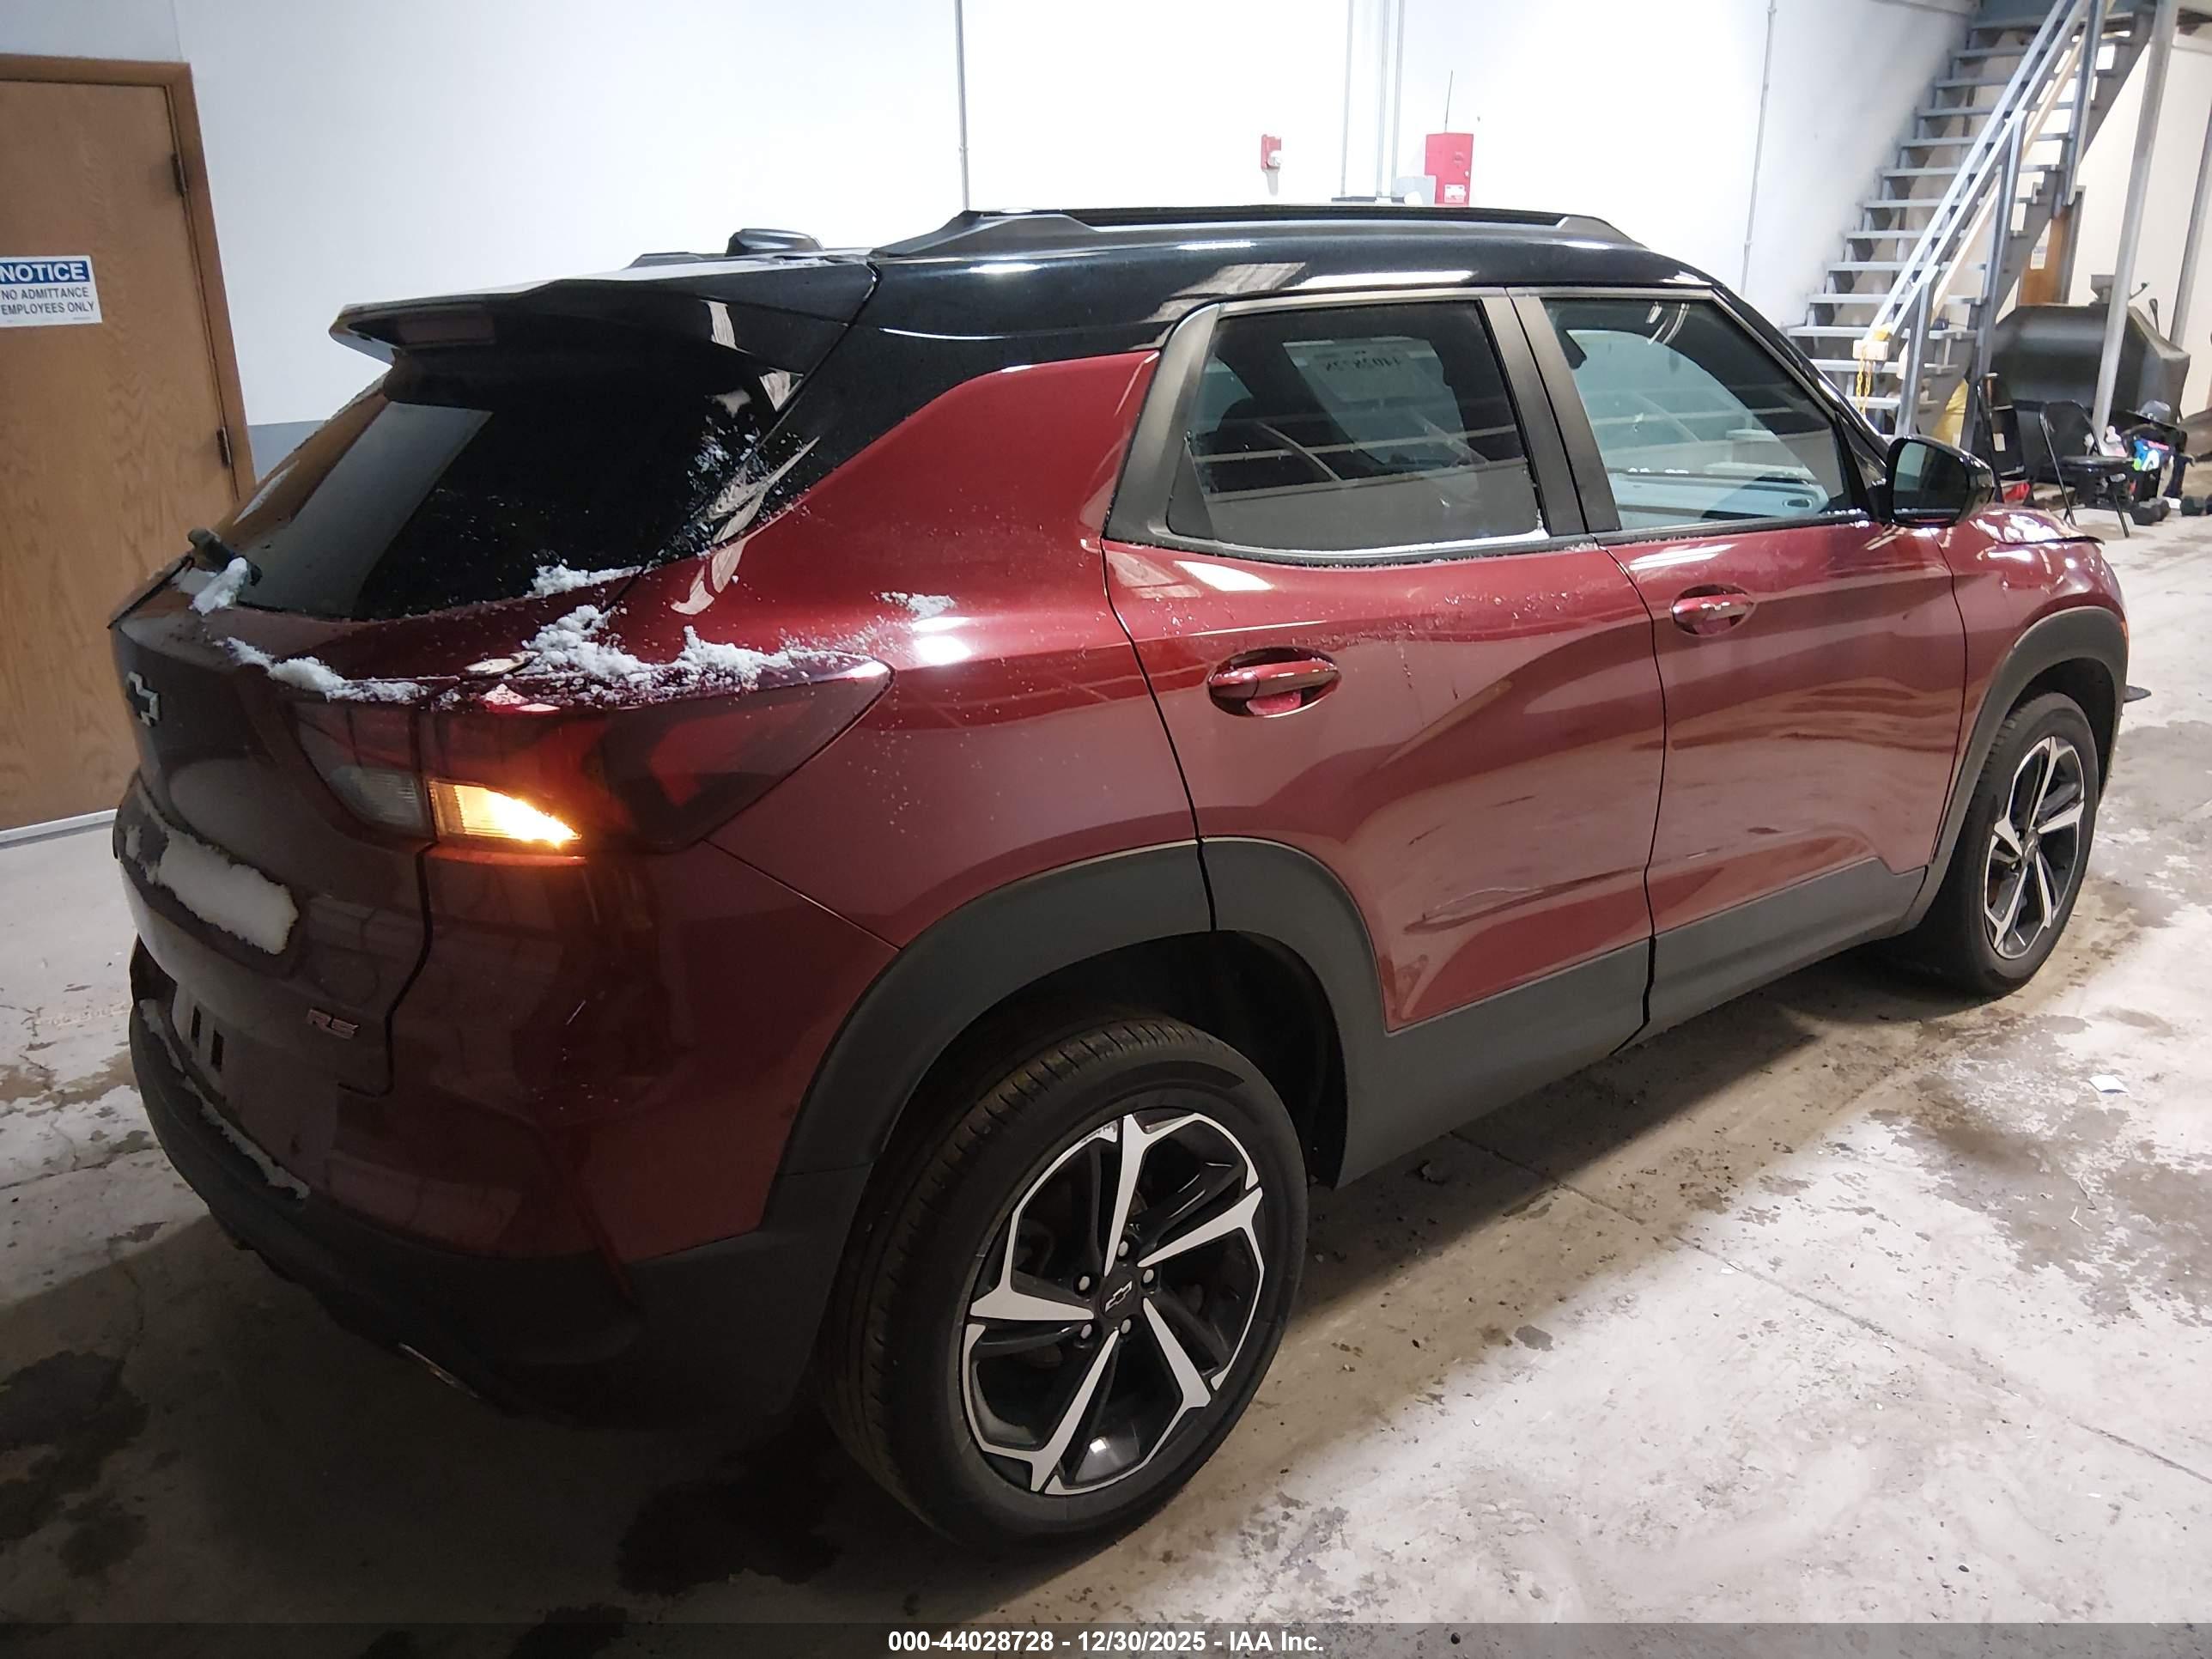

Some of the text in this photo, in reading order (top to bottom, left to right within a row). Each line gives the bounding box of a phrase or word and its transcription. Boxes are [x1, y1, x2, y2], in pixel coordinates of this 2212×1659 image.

[0, 263, 87, 283] NOTICE
[2, 287, 89, 301] NO ADMITTANCE
[2, 301, 94, 315] EMPLOYEES ONLY
[308, 1009, 359, 1040] RS
